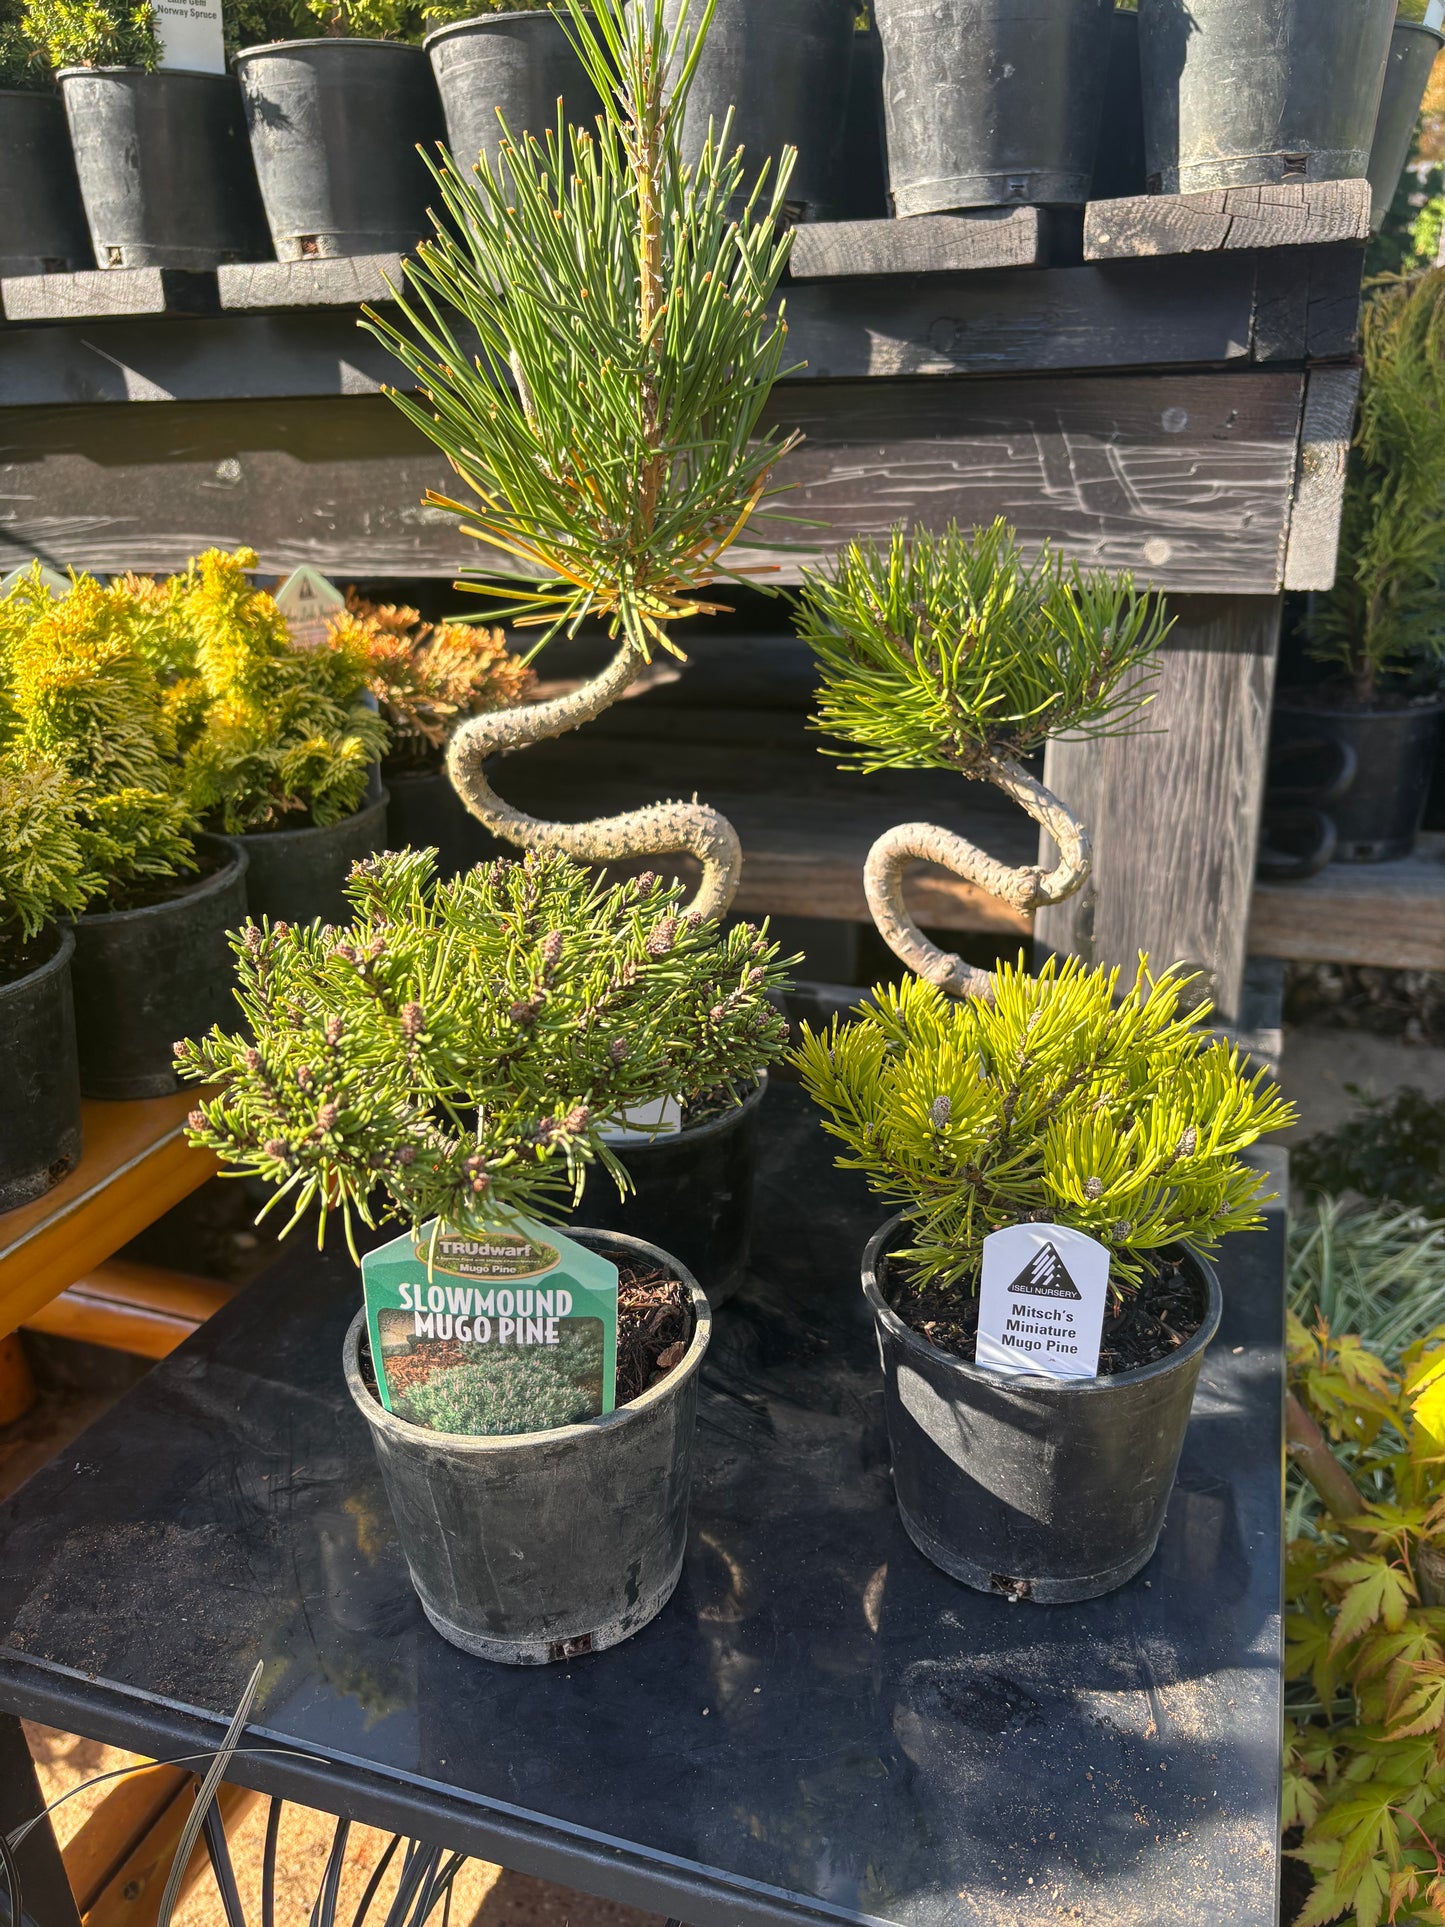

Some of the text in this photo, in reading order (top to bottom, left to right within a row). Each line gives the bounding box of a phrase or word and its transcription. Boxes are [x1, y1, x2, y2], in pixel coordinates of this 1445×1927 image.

[157, 4, 217, 19] Norway Spruce
[439, 1241, 532, 1257] TRUdwarf
[459, 1264, 517, 1273] Mugo Pine
[398, 1282, 573, 1317] SLOWMOUND
[1012, 1284, 1078, 1298] ISELI NURSERY
[1011, 1303, 1074, 1322] Mitsch's
[414, 1311, 560, 1344] MUGO PINE
[1006, 1319, 1077, 1339] Miniature
[1001, 1334, 1078, 1354] Mugo Pine
